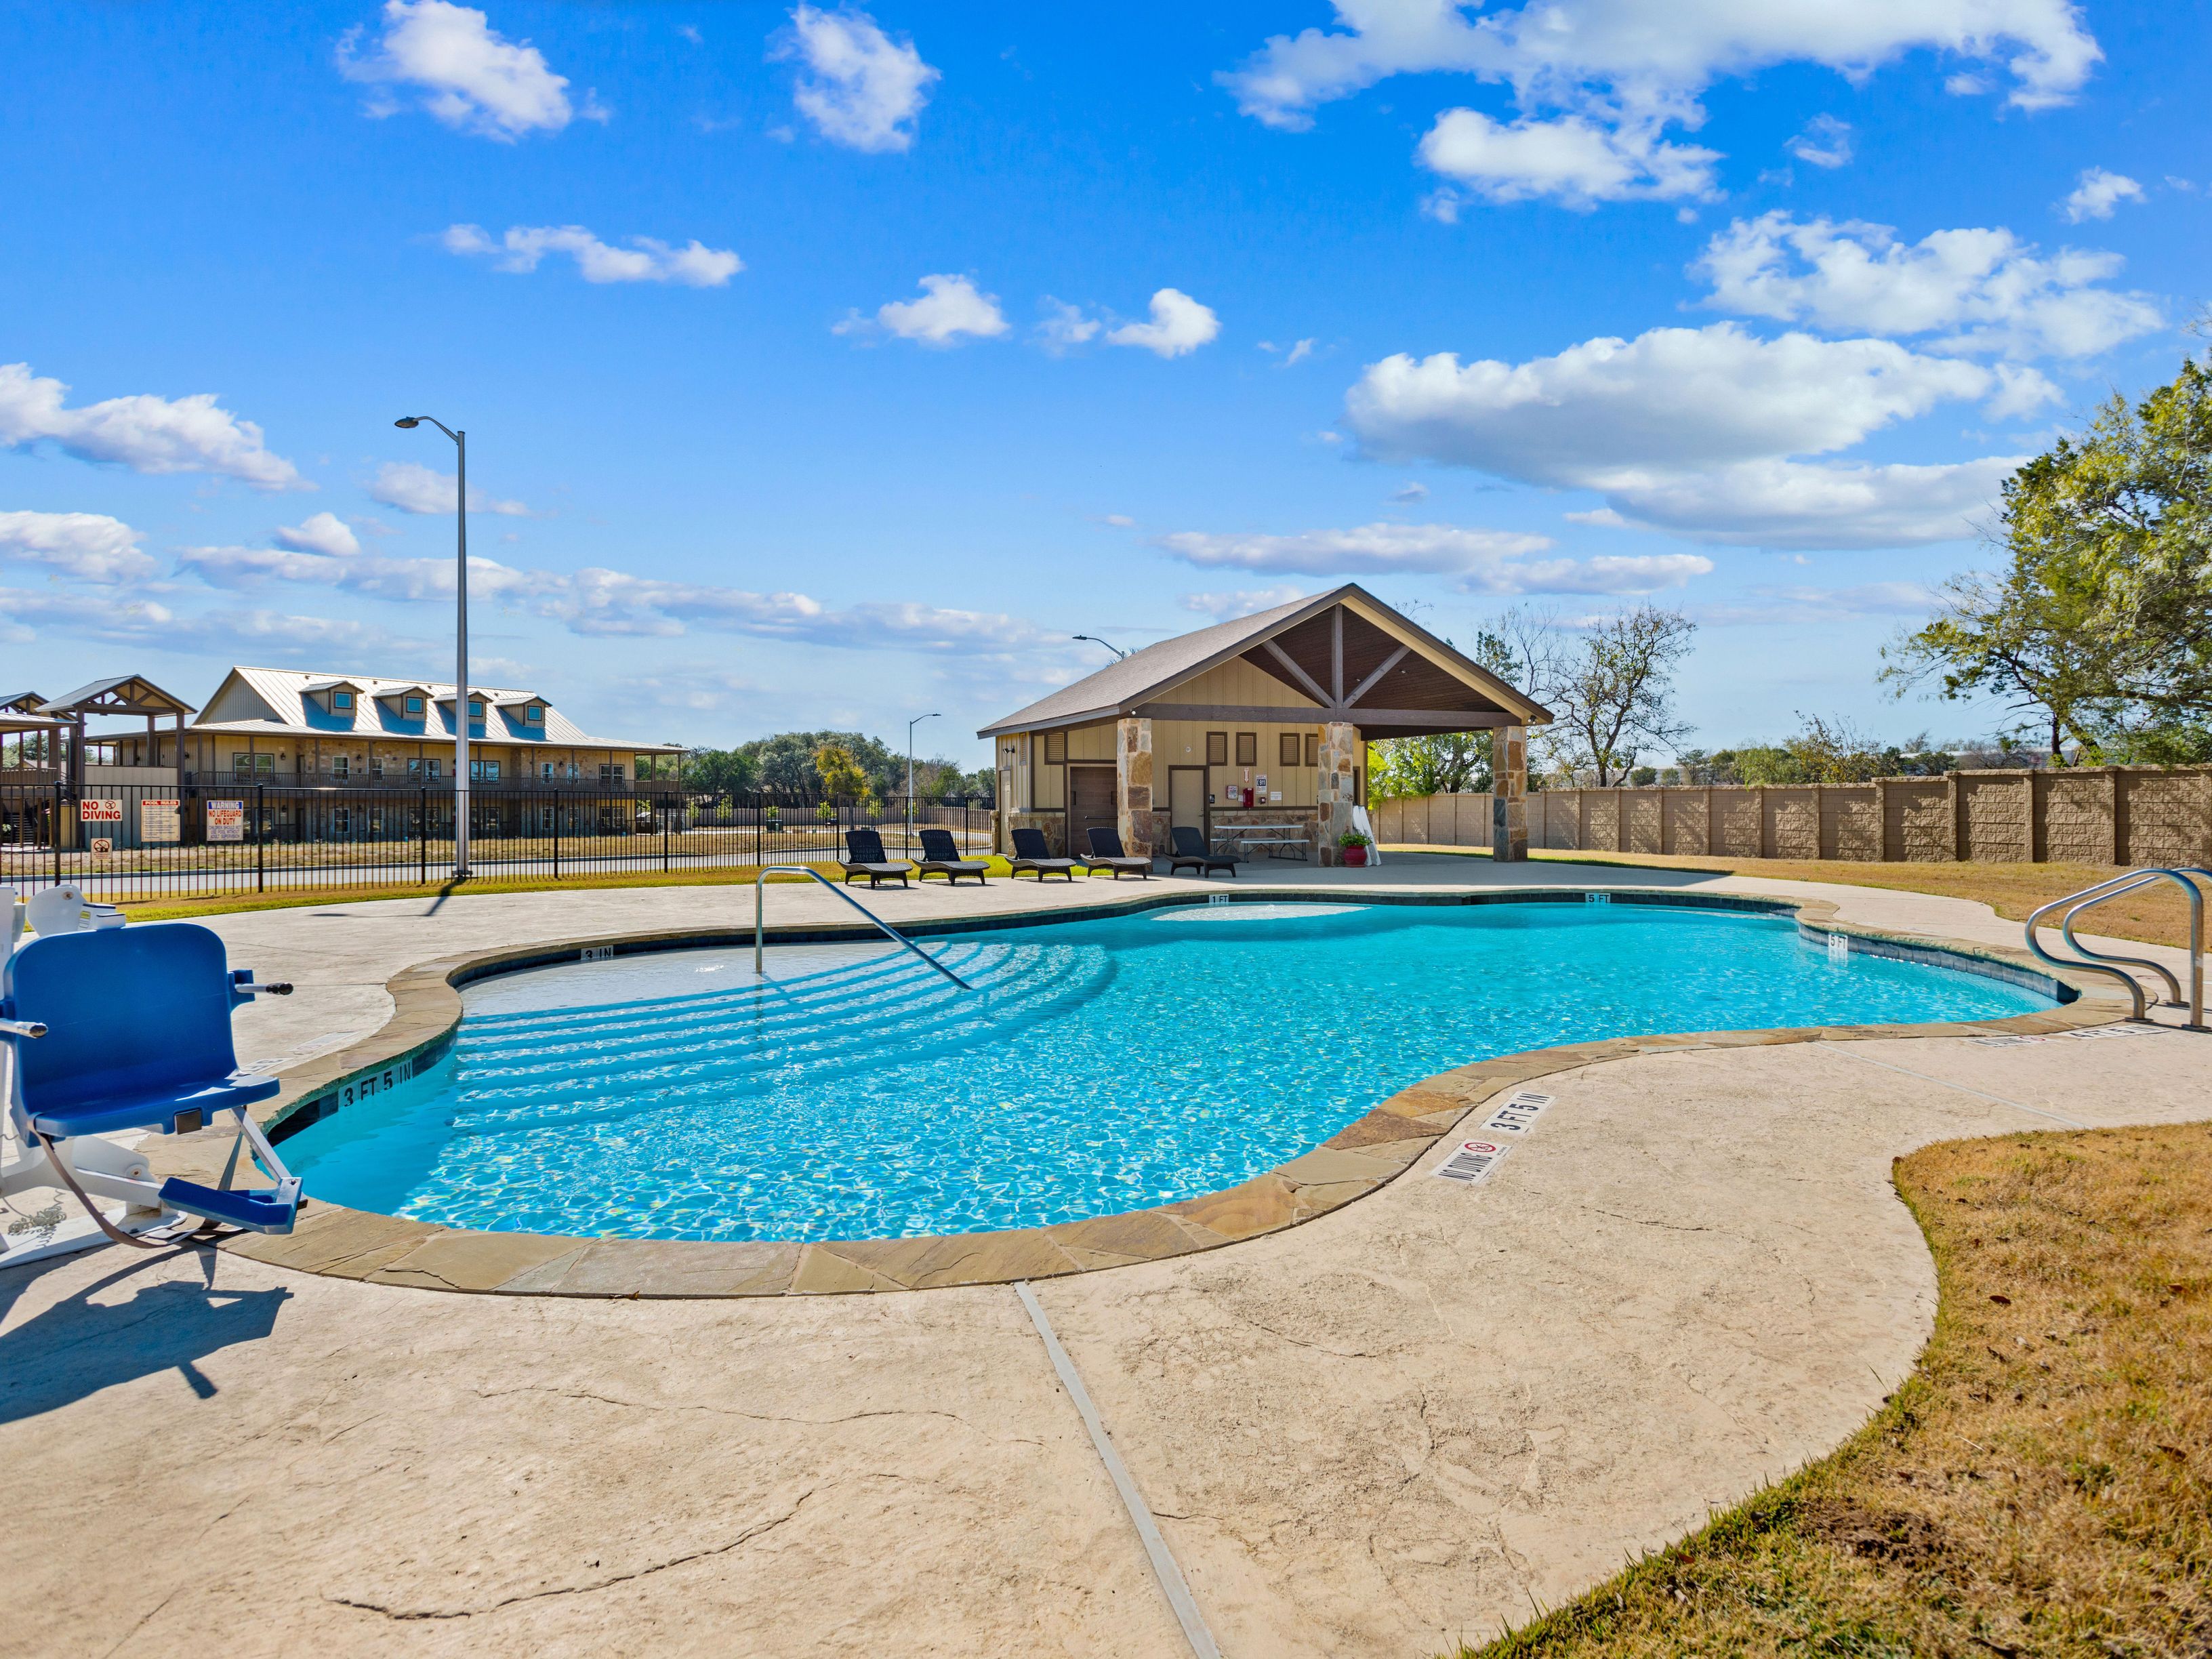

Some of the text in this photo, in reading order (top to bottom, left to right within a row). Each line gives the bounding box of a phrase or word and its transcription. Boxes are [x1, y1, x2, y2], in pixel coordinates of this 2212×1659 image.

[83, 801, 98, 810] NO
[83, 811, 121, 819] DIVING
[1589, 895, 1610, 903] 5 FT
[1830, 935, 1847, 949] 5 FT
[599, 947, 611, 958] IN
[344, 1062, 411, 1107] 3 FT 5 IN
[1517, 1092, 1550, 1103] IN
[1496, 1110, 1532, 1123] FT
[1490, 1122, 1521, 1130] 3
[1438, 1153, 1493, 1181] NO DIVING
